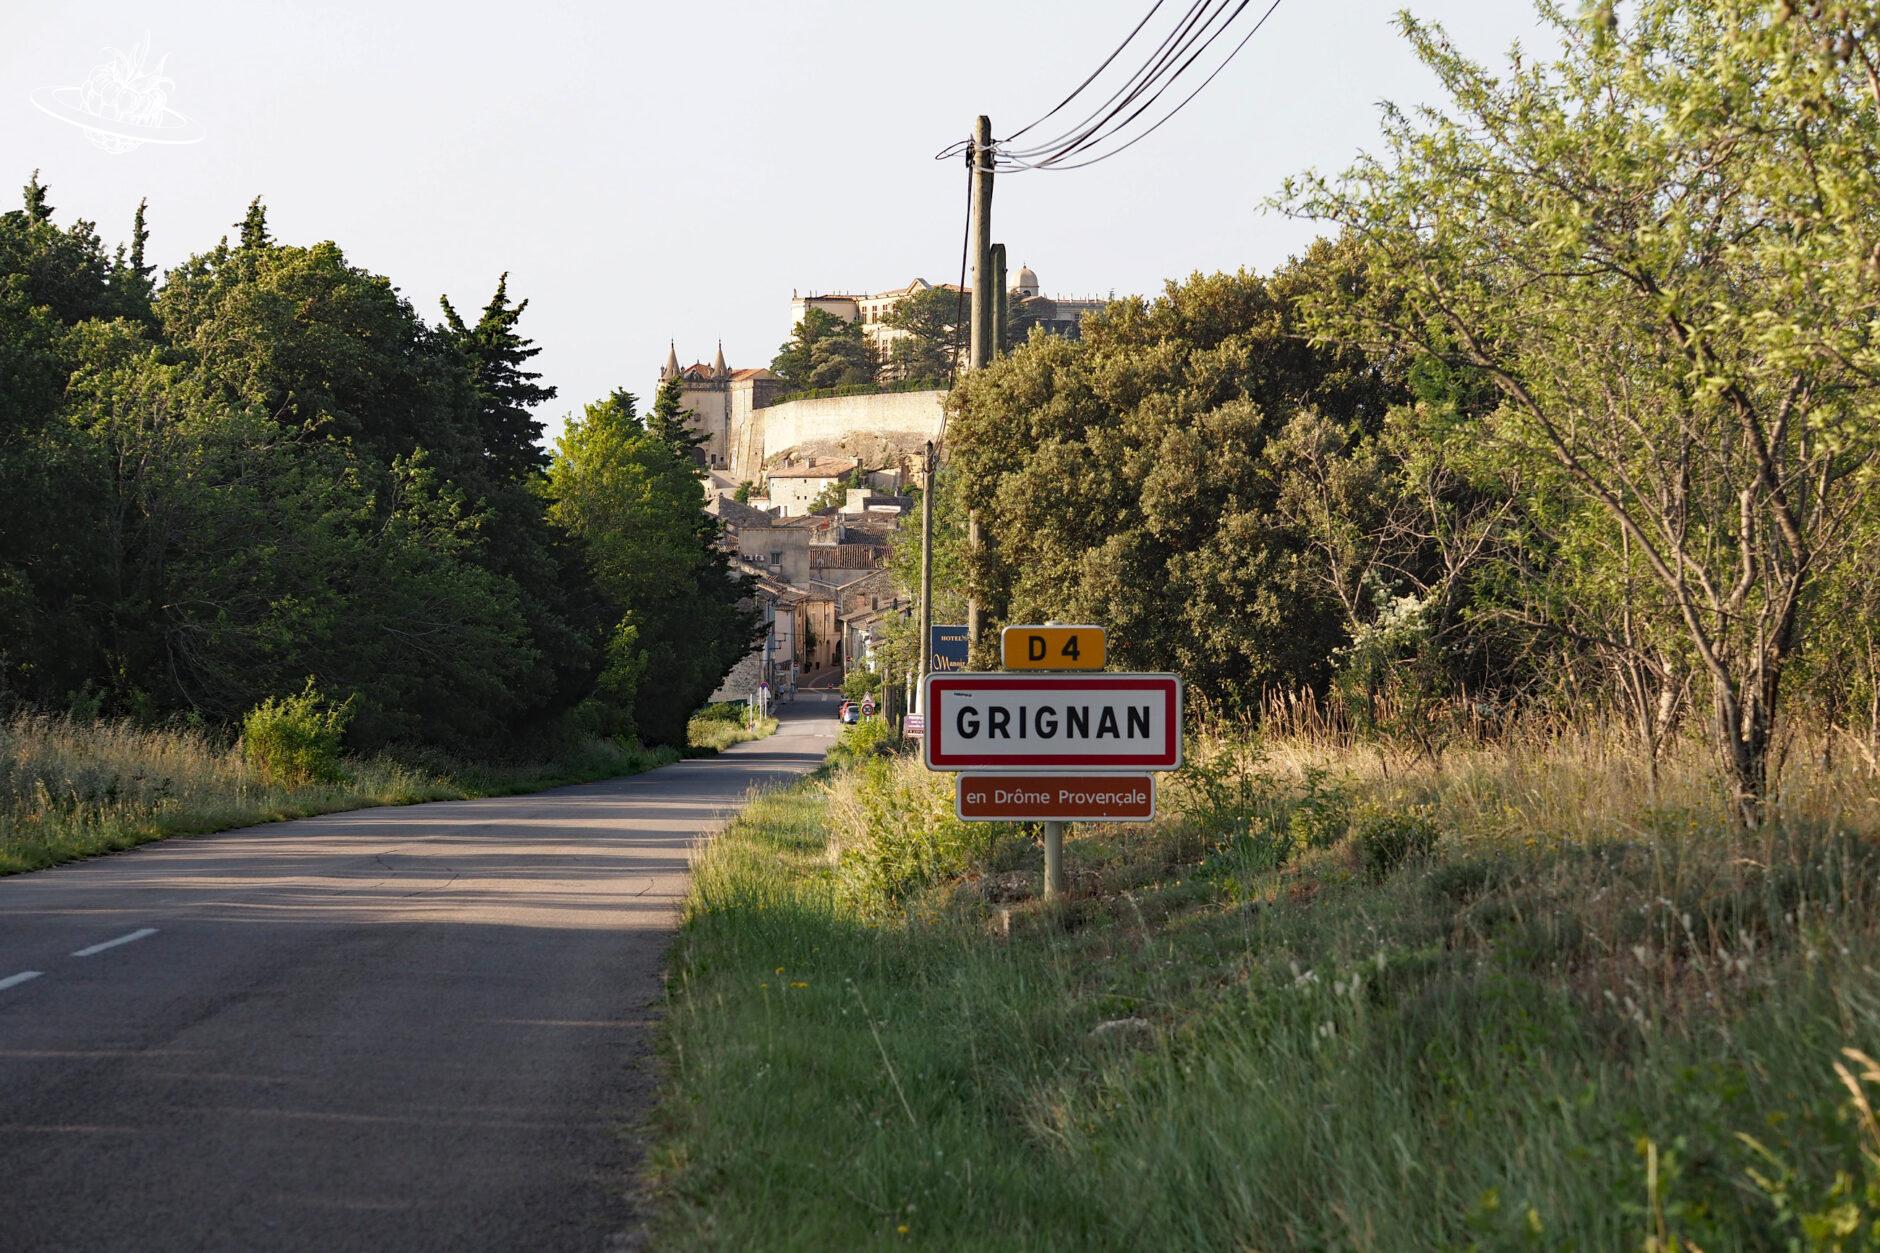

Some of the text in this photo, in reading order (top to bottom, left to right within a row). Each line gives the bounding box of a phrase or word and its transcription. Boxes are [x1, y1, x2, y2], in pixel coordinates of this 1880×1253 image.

[1029, 635, 1080, 661] D 4
[956, 705, 1150, 739] GRIGNAN
[967, 788, 1146, 806] en Drôme Provençale
